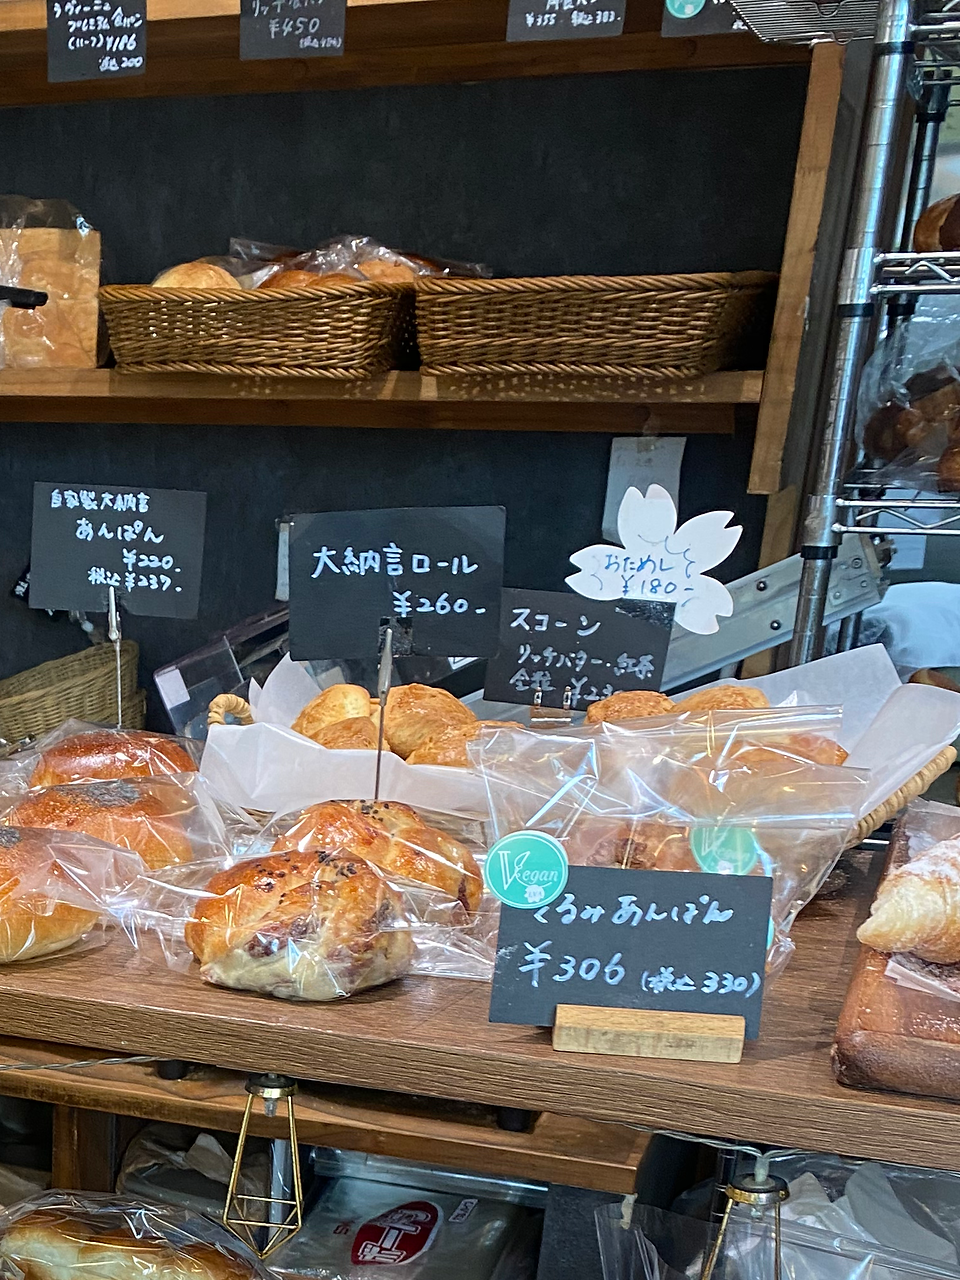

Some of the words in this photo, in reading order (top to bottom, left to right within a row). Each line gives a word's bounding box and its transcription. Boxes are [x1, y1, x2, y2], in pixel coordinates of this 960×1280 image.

[268, 16, 321, 39] ¥450
[75, 516, 165, 544] あんぱん
[310, 541, 479, 579] 大納言ロール
[604, 553, 675, 574] おためし
[509, 608, 602, 637] スコーン
[497, 850, 559, 891] Vegan
[518, 940, 626, 988] ¥306
